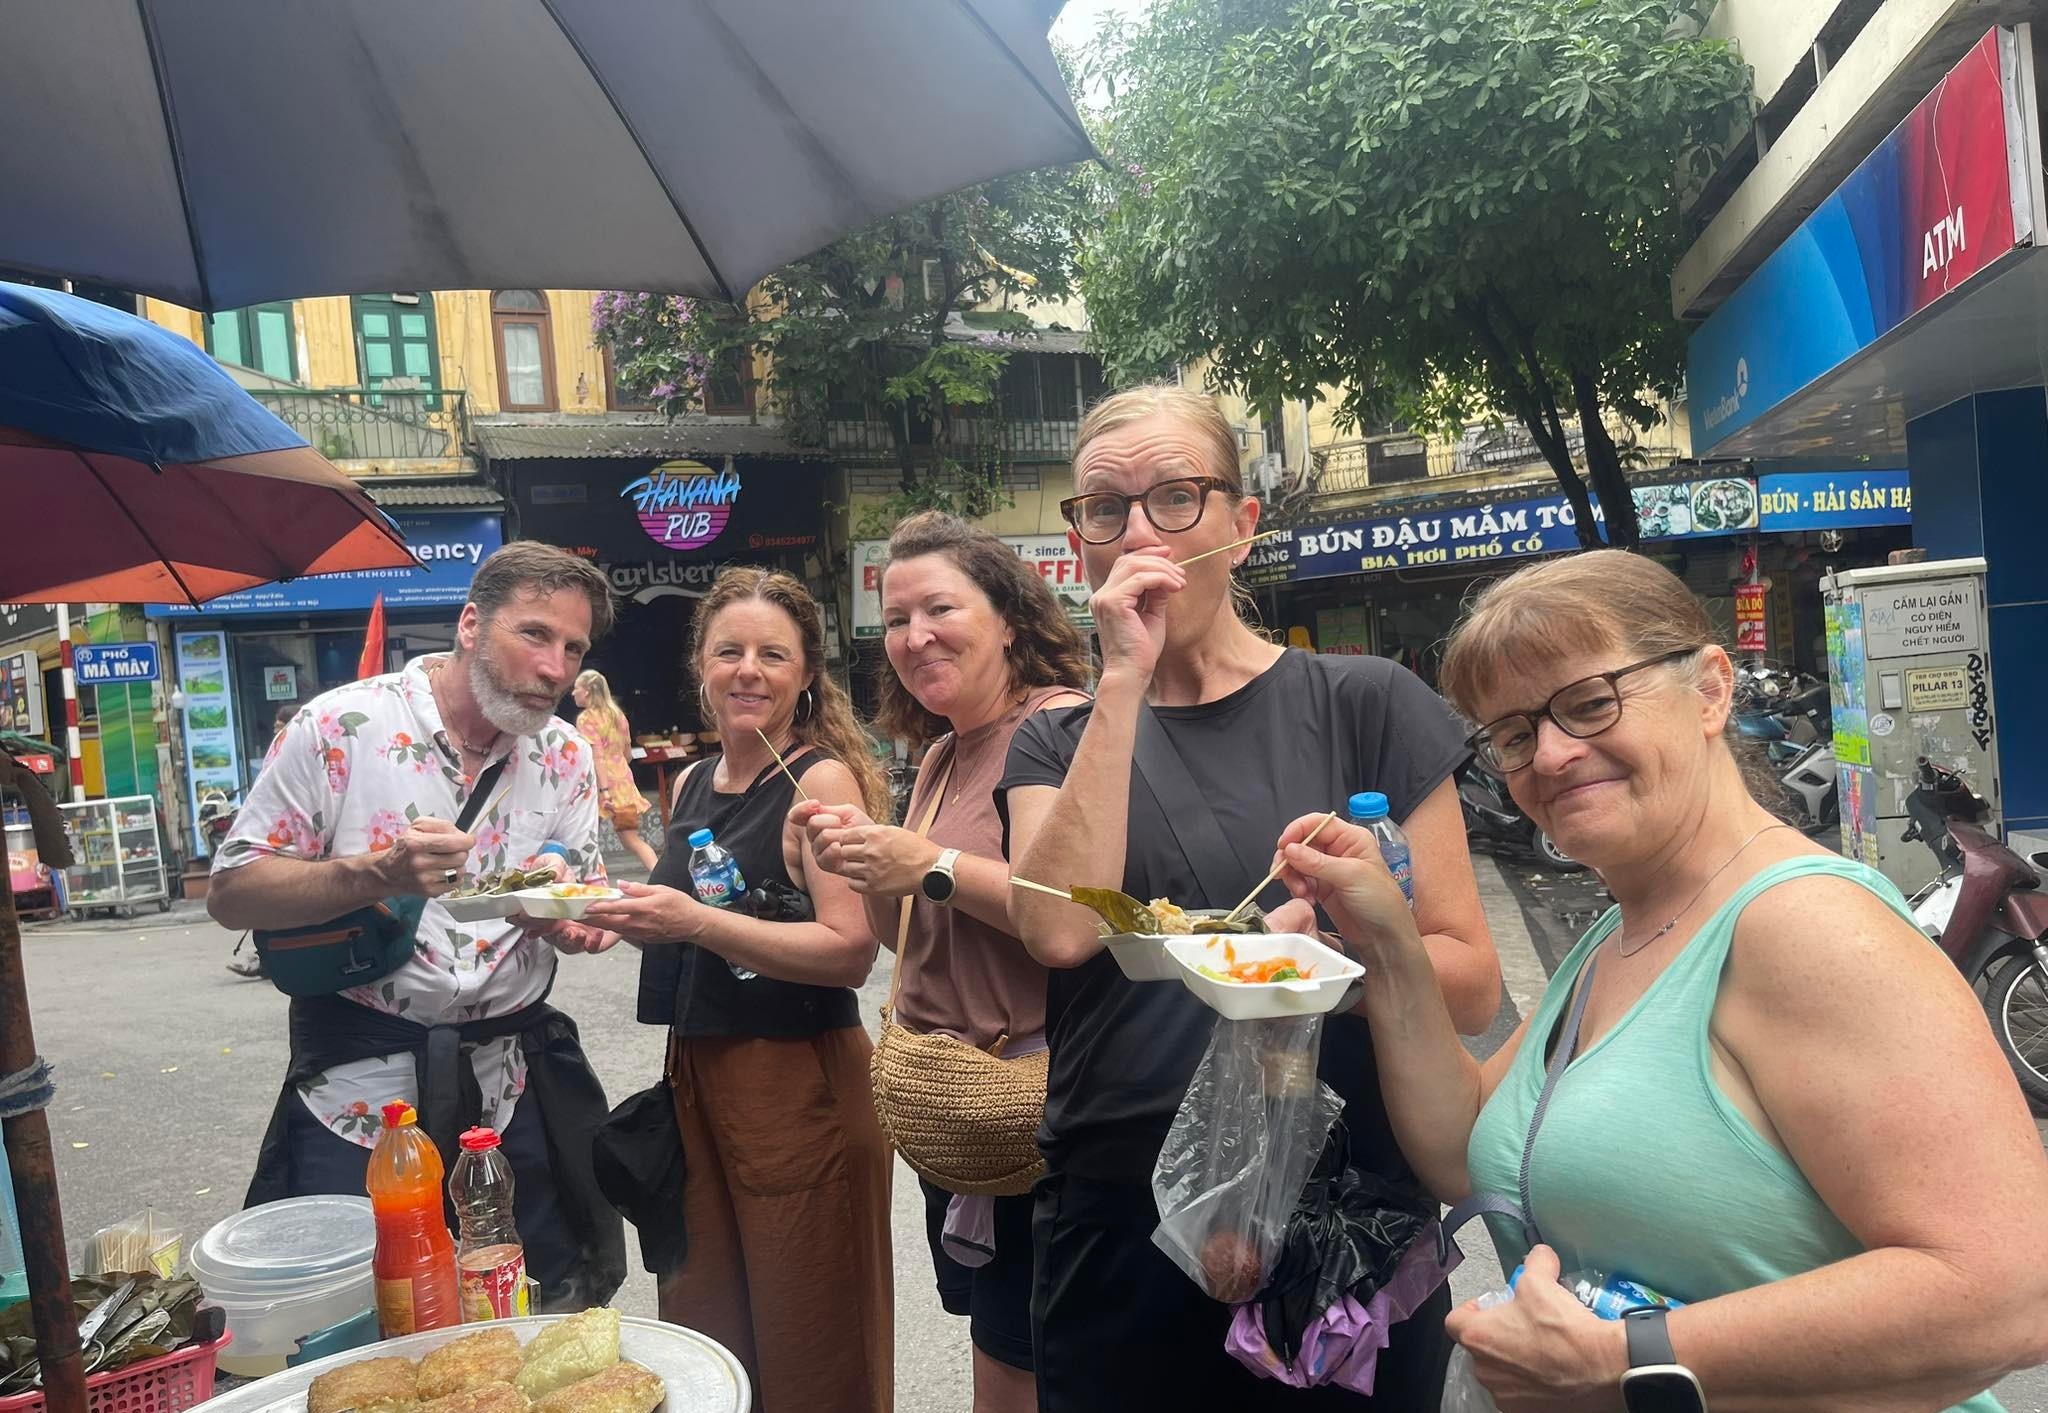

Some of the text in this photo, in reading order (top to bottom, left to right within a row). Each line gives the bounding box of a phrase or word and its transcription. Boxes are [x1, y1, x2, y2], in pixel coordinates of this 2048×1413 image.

[1923, 206, 1967, 280] ATM
[620, 471, 742, 517] HAVANA
[1761, 487, 1799, 514] BÚN
[1813, 482, 1846, 512] HẢI
[1850, 481, 1886, 509] SẢN
[664, 512, 712, 540] PUB
[1299, 528, 1363, 557] BÚN
[1371, 517, 1441, 551] ĐẬU
[1450, 504, 1527, 538] MẮM
[1252, 530, 1293, 547] ANH
[407, 543, 483, 564] ency
[1035, 545, 1066, 556] since
[1361, 554, 1399, 571] BIA
[1407, 548, 1448, 566] HƠI
[1455, 536, 1503, 560] PHỐ
[1920, 596, 1936, 610] LẠI
[1905, 624, 1933, 634] NGUY
[102, 647, 129, 659] PHỐ
[83, 658, 149, 678] MÃ MÂY
[1912, 680, 1963, 692] PILLAR 13
